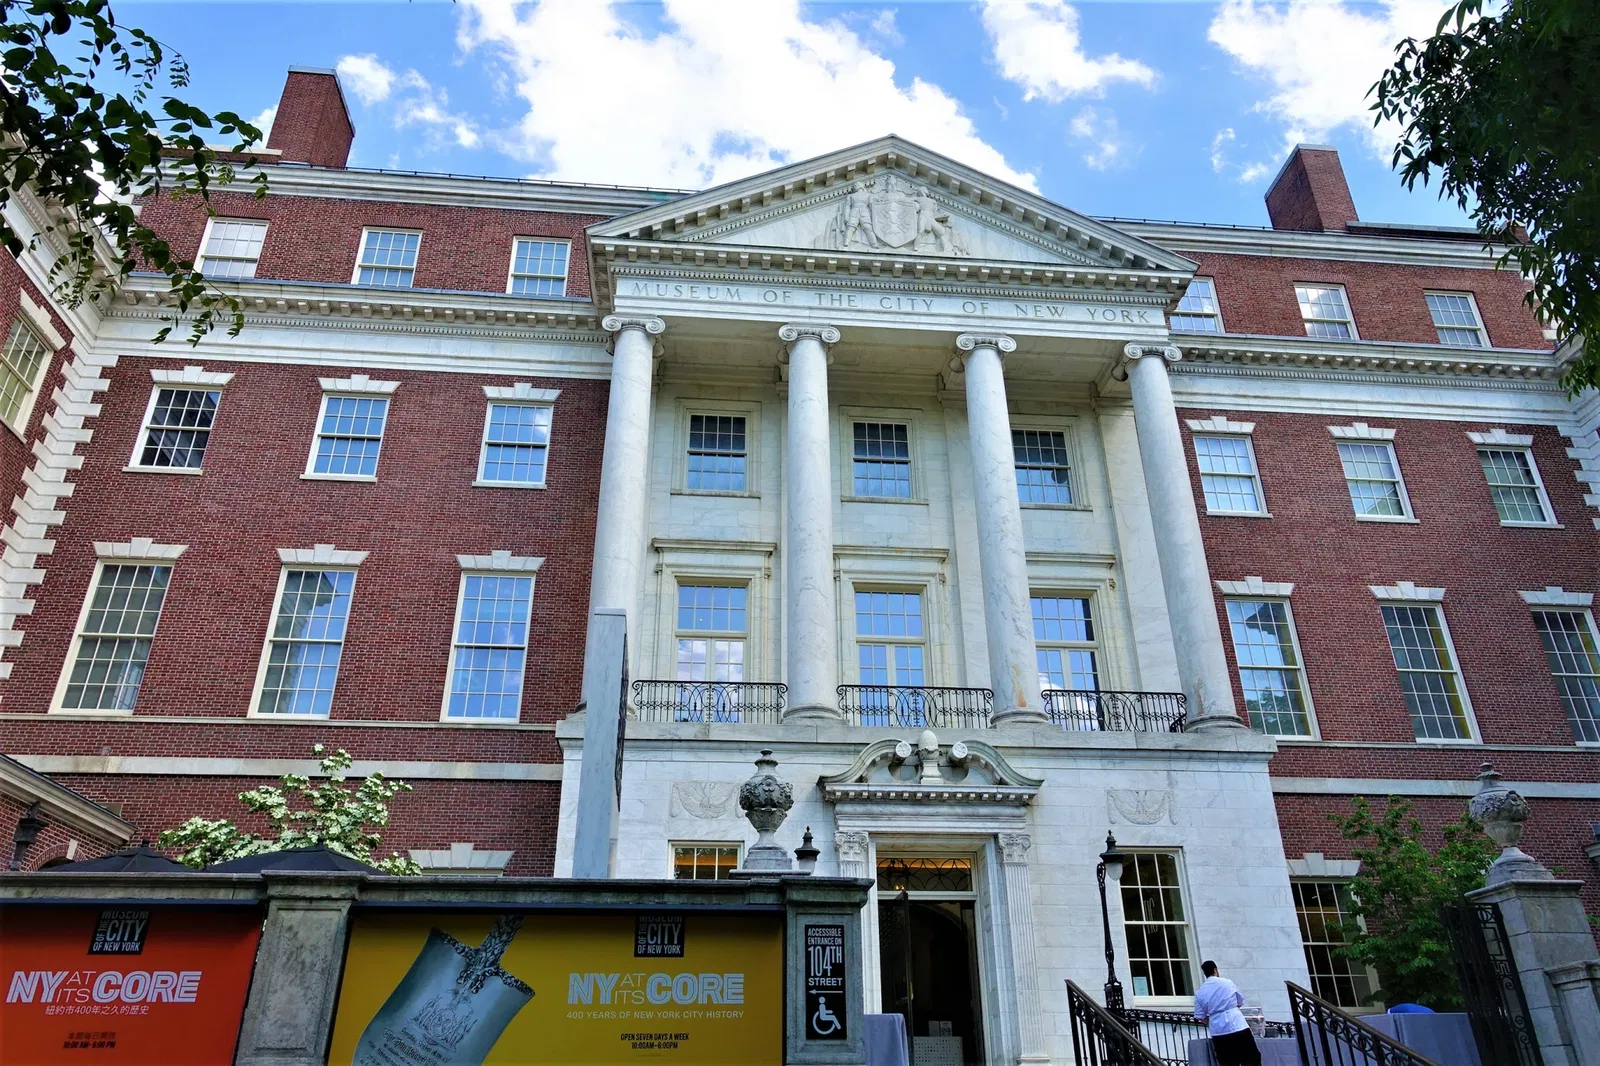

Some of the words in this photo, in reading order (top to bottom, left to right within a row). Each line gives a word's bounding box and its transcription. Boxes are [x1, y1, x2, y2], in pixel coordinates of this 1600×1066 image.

[631, 282, 742, 301] MUSEUM
[763, 290, 792, 303] OF
[814, 292, 858, 308] THE
[880, 296, 935, 312] CITY
[962, 300, 988, 314] OF
[1015, 303, 1066, 318] NEW
[1086, 307, 1151, 323] YORK
[102, 911, 149, 919] MUSEUM
[96, 933, 105, 941] OF
[106, 920, 146, 941] CITY
[647, 923, 681, 944] CITY
[808, 928, 842, 937] ACCESSIBLE
[93, 942, 103, 951] OF
[103, 942, 120, 951] NEW
[121, 942, 141, 951] YORK
[638, 935, 646, 944] OF
[808, 937, 834, 945] ENTRANCE
[834, 937, 842, 945] ON
[638, 945, 646, 954] OF
[647, 945, 662, 954] NEW
[663, 945, 681, 954] YORK
[66, 971, 96, 985] AT
[620, 973, 646, 987] AT
[808, 977, 843, 986] STREET
[6, 971, 68, 1003] NY
[92, 971, 202, 1003] CORE
[567, 973, 620, 1004] NY
[645, 973, 744, 1004] CORE
[56, 988, 91, 1003] ITS
[614, 990, 646, 1005] ITS
[566, 1011, 584, 1019] 400
[587, 1011, 616, 1019] YEARS
[619, 1011, 631, 1019] OF
[633, 1011, 654, 1019] NEW
[656, 1010, 680, 1019] YORK
[683, 1010, 704, 1019] CITY
[706, 1010, 744, 1019] HISTORY
[620, 1033, 635, 1041] OPEN
[636, 1033, 653, 1041] SEVEN
[654, 1033, 668, 1041] DAYS
[674, 1033, 689, 1041] WEEK
